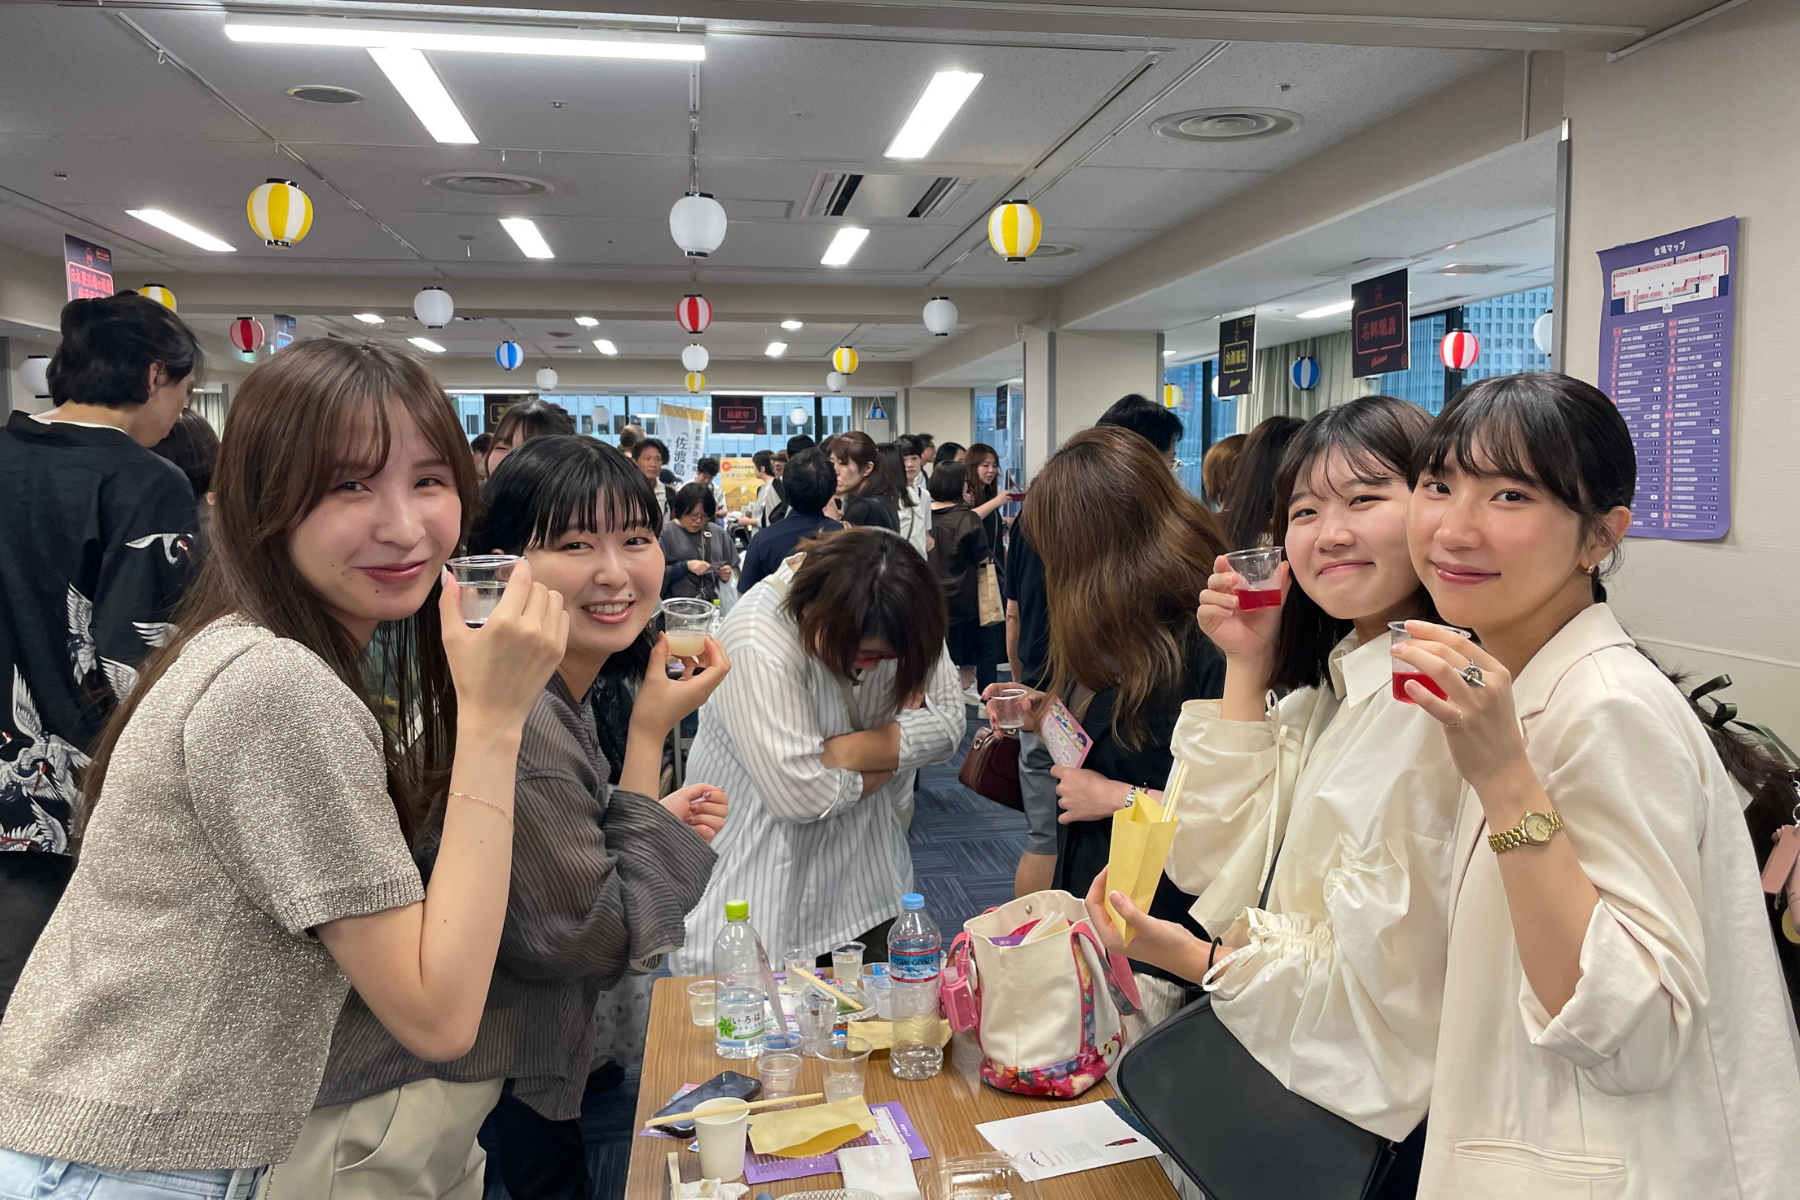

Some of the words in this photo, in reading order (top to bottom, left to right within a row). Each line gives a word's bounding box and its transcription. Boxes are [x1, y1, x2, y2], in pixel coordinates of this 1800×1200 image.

[1653, 240, 1686, 257] 会場マップ
